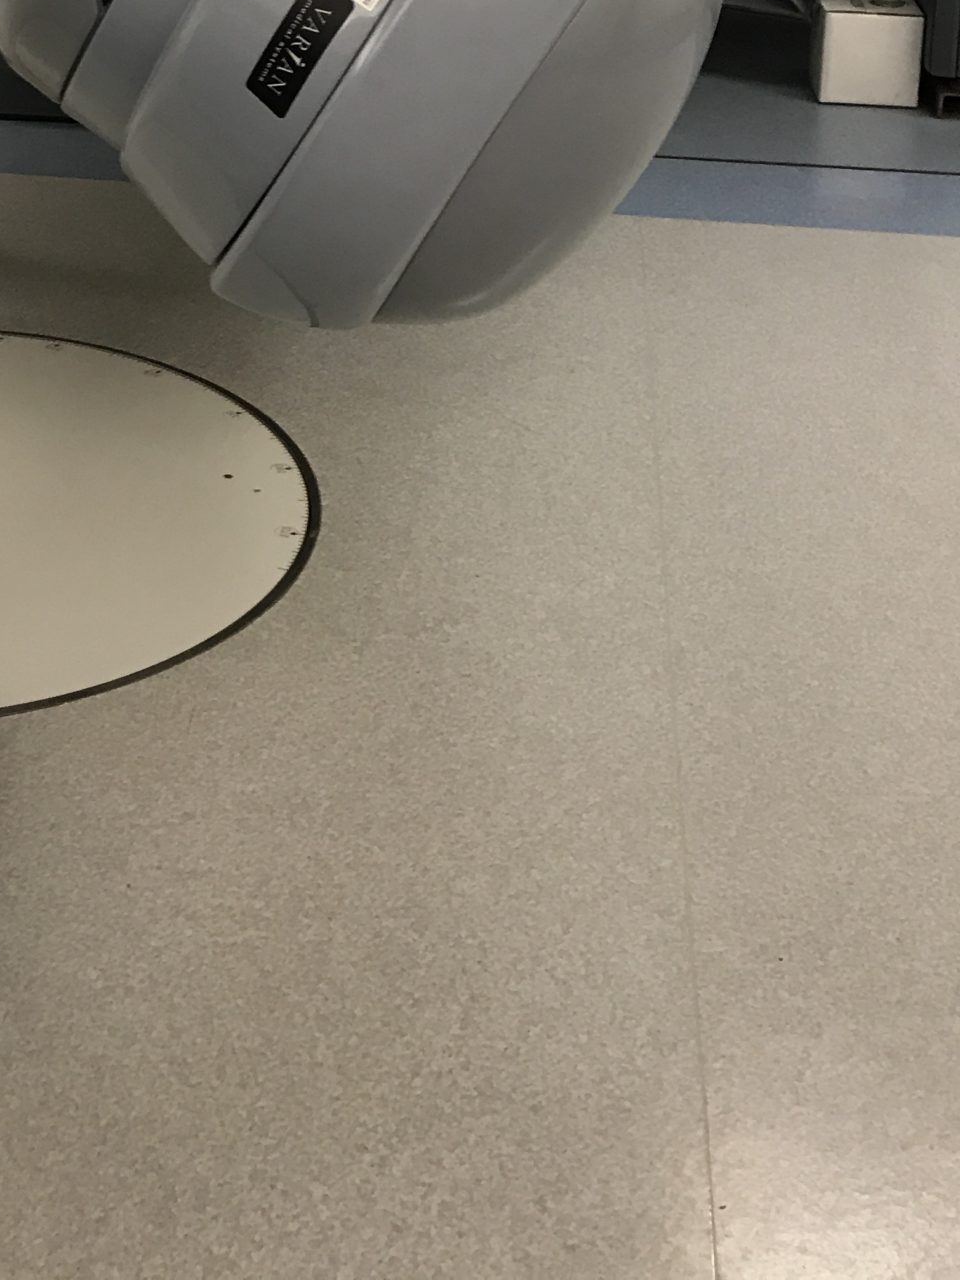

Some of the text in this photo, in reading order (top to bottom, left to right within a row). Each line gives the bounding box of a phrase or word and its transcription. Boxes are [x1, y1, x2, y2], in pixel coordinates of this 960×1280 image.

[258, 0, 312, 81] medical systems
[266, 7, 333, 96] VARIAN
